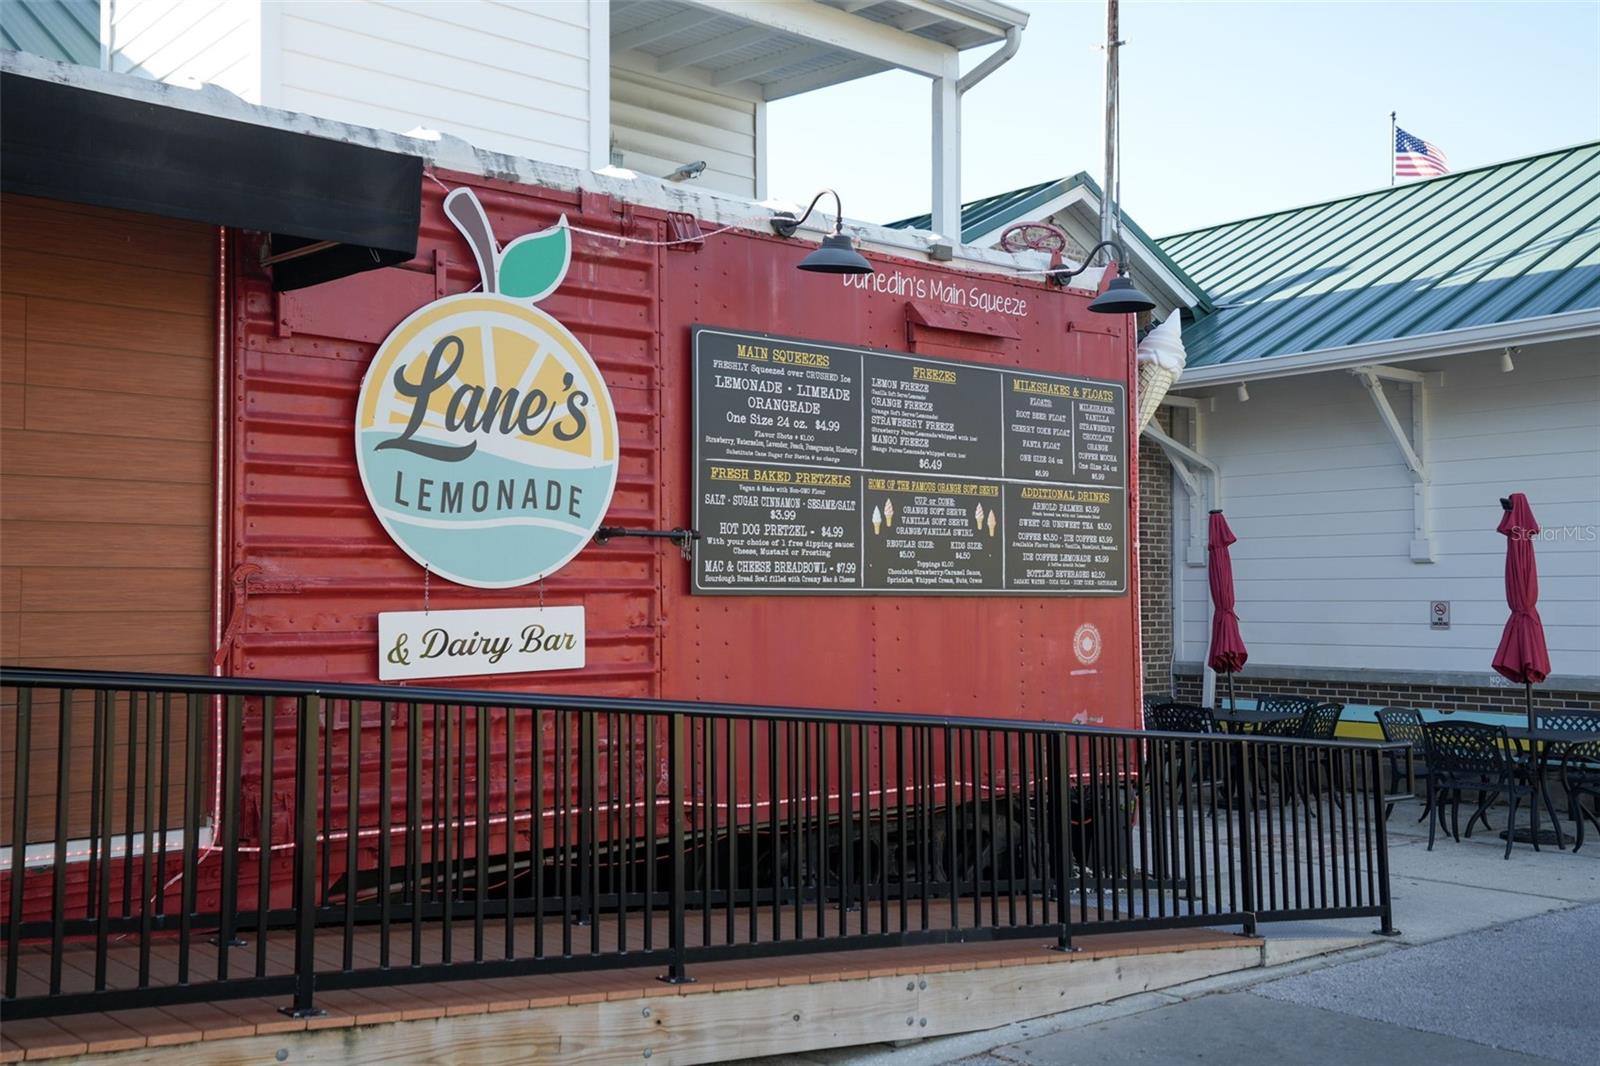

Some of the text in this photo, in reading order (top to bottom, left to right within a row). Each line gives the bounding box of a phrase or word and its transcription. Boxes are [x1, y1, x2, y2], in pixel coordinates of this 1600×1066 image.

[930, 279, 966, 306] Main
[969, 288, 1027, 316] Squeeze
[737, 344, 830, 368] MAIN SQUEEZES
[713, 360, 851, 383] FRESHLY Squeezed over CRUSHED Ice
[913, 366, 957, 384] FREEZES
[714, 375, 850, 401] LEMONADE LIMEADE
[871, 378, 930, 393] LEMON FREEZE
[1013, 379, 1114, 401] MILKSHAKES & FLOATS
[374, 336, 589, 462] Lane's
[748, 397, 821, 415] ORANGEADE
[871, 397, 933, 412] ORANGE FREEZE
[726, 411, 840, 432] One Size 24 oz. $4.99
[871, 416, 955, 433] STRAWBERRY FREEZE
[871, 434, 898, 445] MANGO
[900, 436, 930, 448] FREEZE
[919, 458, 943, 470] $6.49
[711, 467, 851, 487] FRESH BAKED PRETZELS
[868, 478, 885, 490] HOME
[887, 480, 896, 490] OF
[897, 480, 909, 491] THE
[911, 481, 936, 493] FAMOUS
[937, 483, 962, 494] ORANGE
[395, 471, 583, 518] LEMONADE
[704, 494, 856, 511] SALT SUGAR CINNAMON SESAME/SALT
[1021, 487, 1110, 503] ADDITIONAL DRINKS
[770, 510, 796, 521] $3.99
[903, 506, 928, 515] ORANGE
[930, 508, 945, 516] SOFT
[901, 516, 930, 526] VANILLA
[931, 517, 946, 526] SOFT
[719, 522, 844, 538] HOT DOG PRETZEL $4.99
[706, 537, 725, 545] With
[726, 538, 745, 547] your
[746, 538, 769, 547] choice
[771, 538, 780, 547] of
[787, 540, 803, 548] free
[805, 540, 833, 549] dipping
[886, 539, 916, 549] REGULAR
[732, 547, 758, 557] Cheese,
[760, 548, 789, 556] Mustard
[801, 548, 831, 558] Frosting
[704, 560, 857, 574] MAC & CHEESE BREADBOWL $7.99
[387, 624, 577, 665] & Dairy Bar
